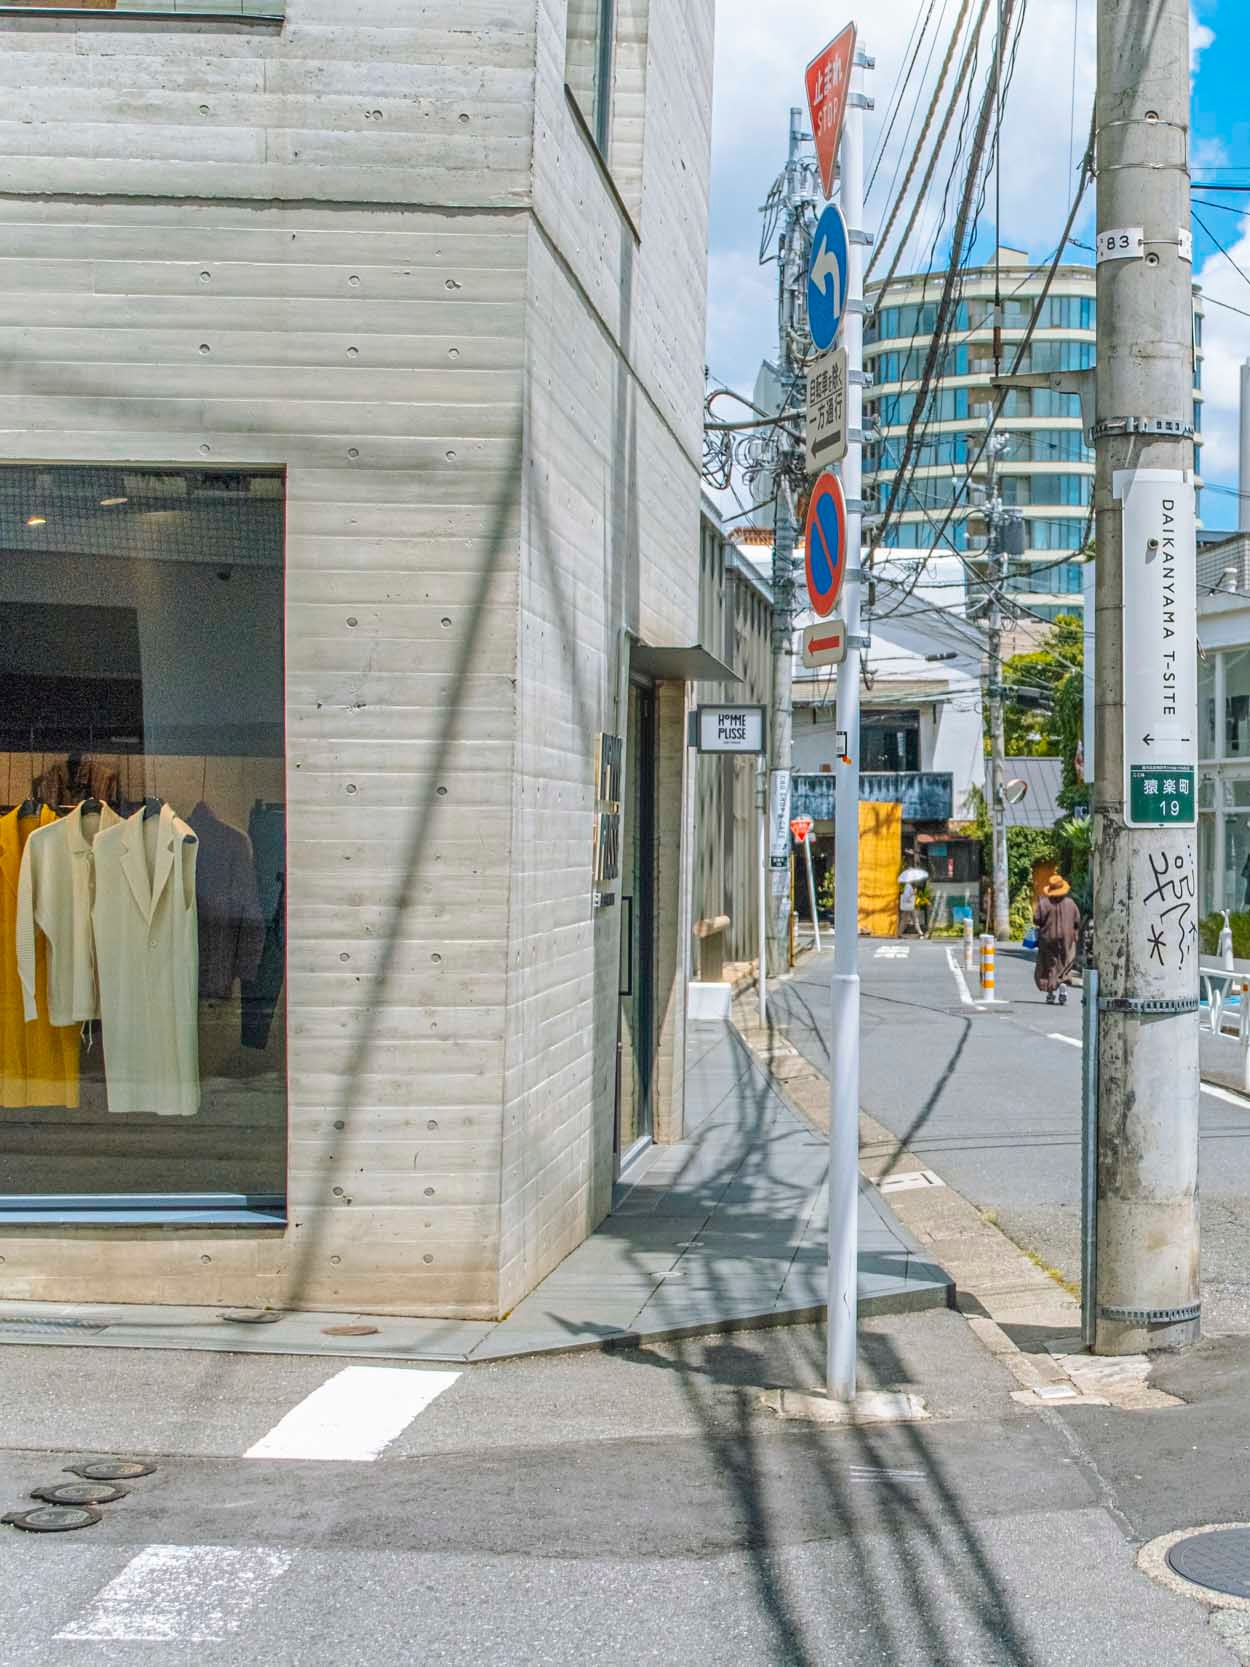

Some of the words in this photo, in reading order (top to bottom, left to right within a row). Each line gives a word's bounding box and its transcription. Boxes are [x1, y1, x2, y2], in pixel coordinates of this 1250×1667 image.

[813, 53, 842, 106] 止まれ
[817, 97, 838, 137] STOP
[1107, 235, 1130, 250] 83
[809, 361, 843, 405] 自転車を除く
[809, 391, 842, 432] 一方通行
[1162, 499, 1175, 640] DAIKANYAMA
[1163, 651, 1176, 715] T-SITE
[718, 713, 746, 727] HOMME
[1143, 779, 1189, 795] 猿楽町
[1160, 800, 1180, 816] 19
